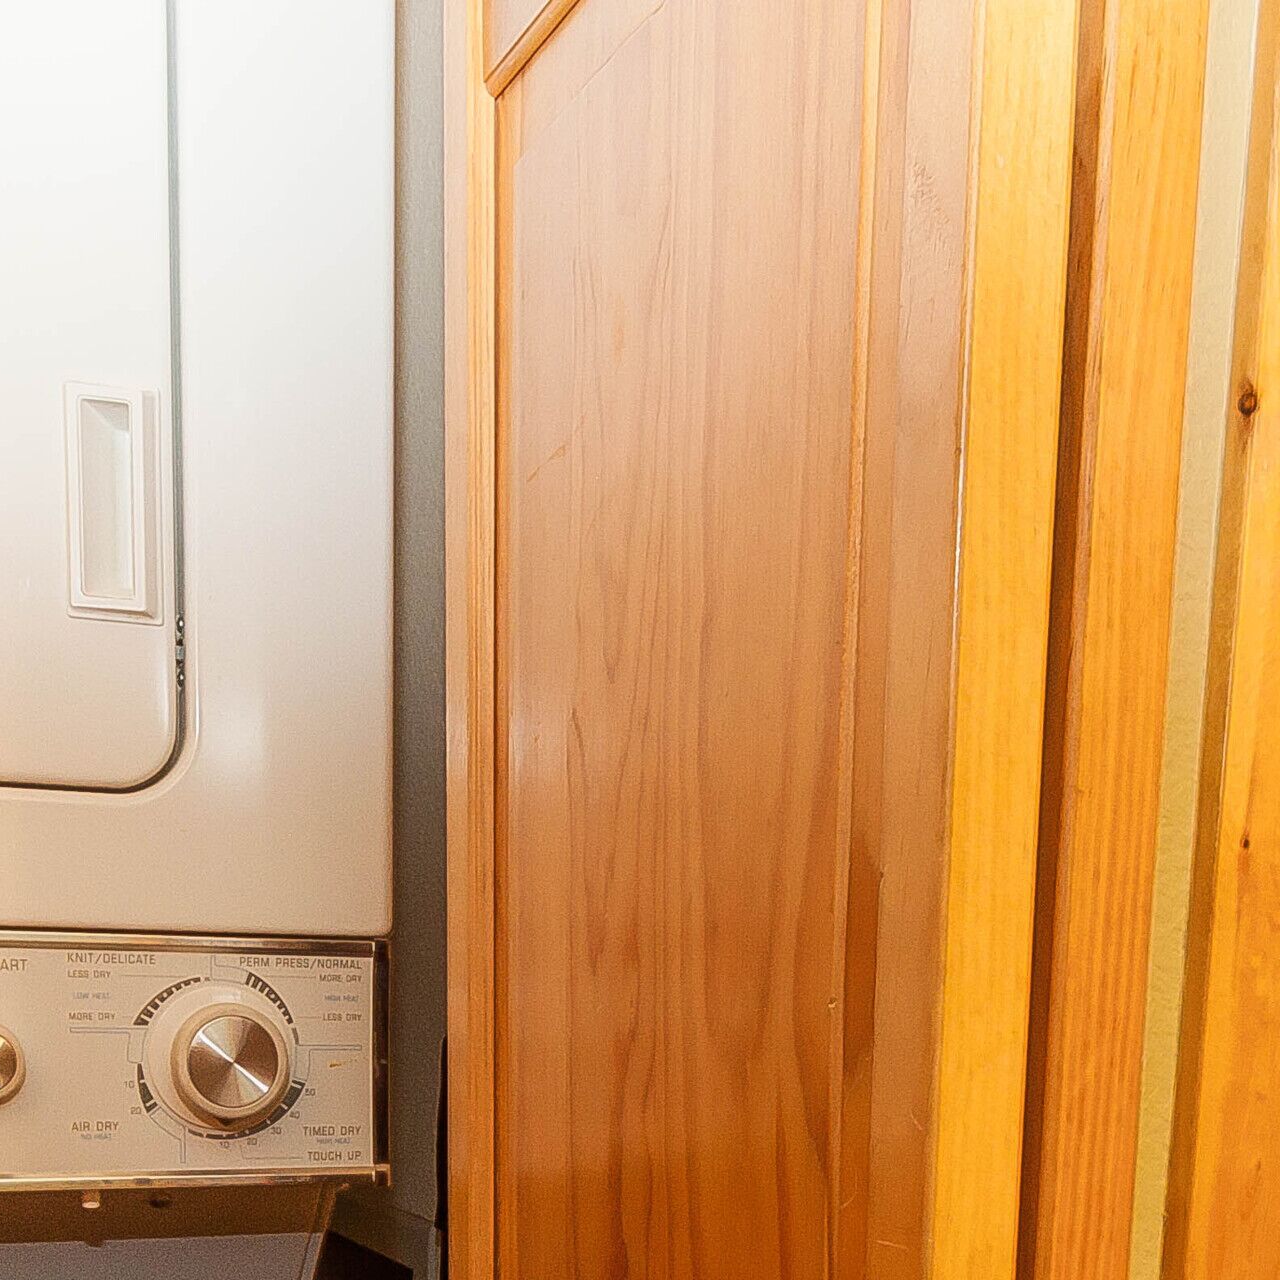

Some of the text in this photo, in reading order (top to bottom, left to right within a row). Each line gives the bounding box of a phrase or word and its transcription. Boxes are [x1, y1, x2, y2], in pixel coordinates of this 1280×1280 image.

[67, 952, 156, 965] KNIT/DELICATE
[240, 957, 362, 970] PERM PRESS/NORMAL
[67, 970, 111, 979] LESS DRY
[319, 974, 362, 983] MORE DRY
[68, 1012, 116, 1021] MORE DRY
[323, 1013, 362, 1022] LESS DRY
[123, 1080, 135, 1089] 10
[71, 1120, 119, 1132] AIR DRY
[303, 1125, 361, 1137] TIMED DRY
[307, 1150, 362, 1162] TOUCH UP
